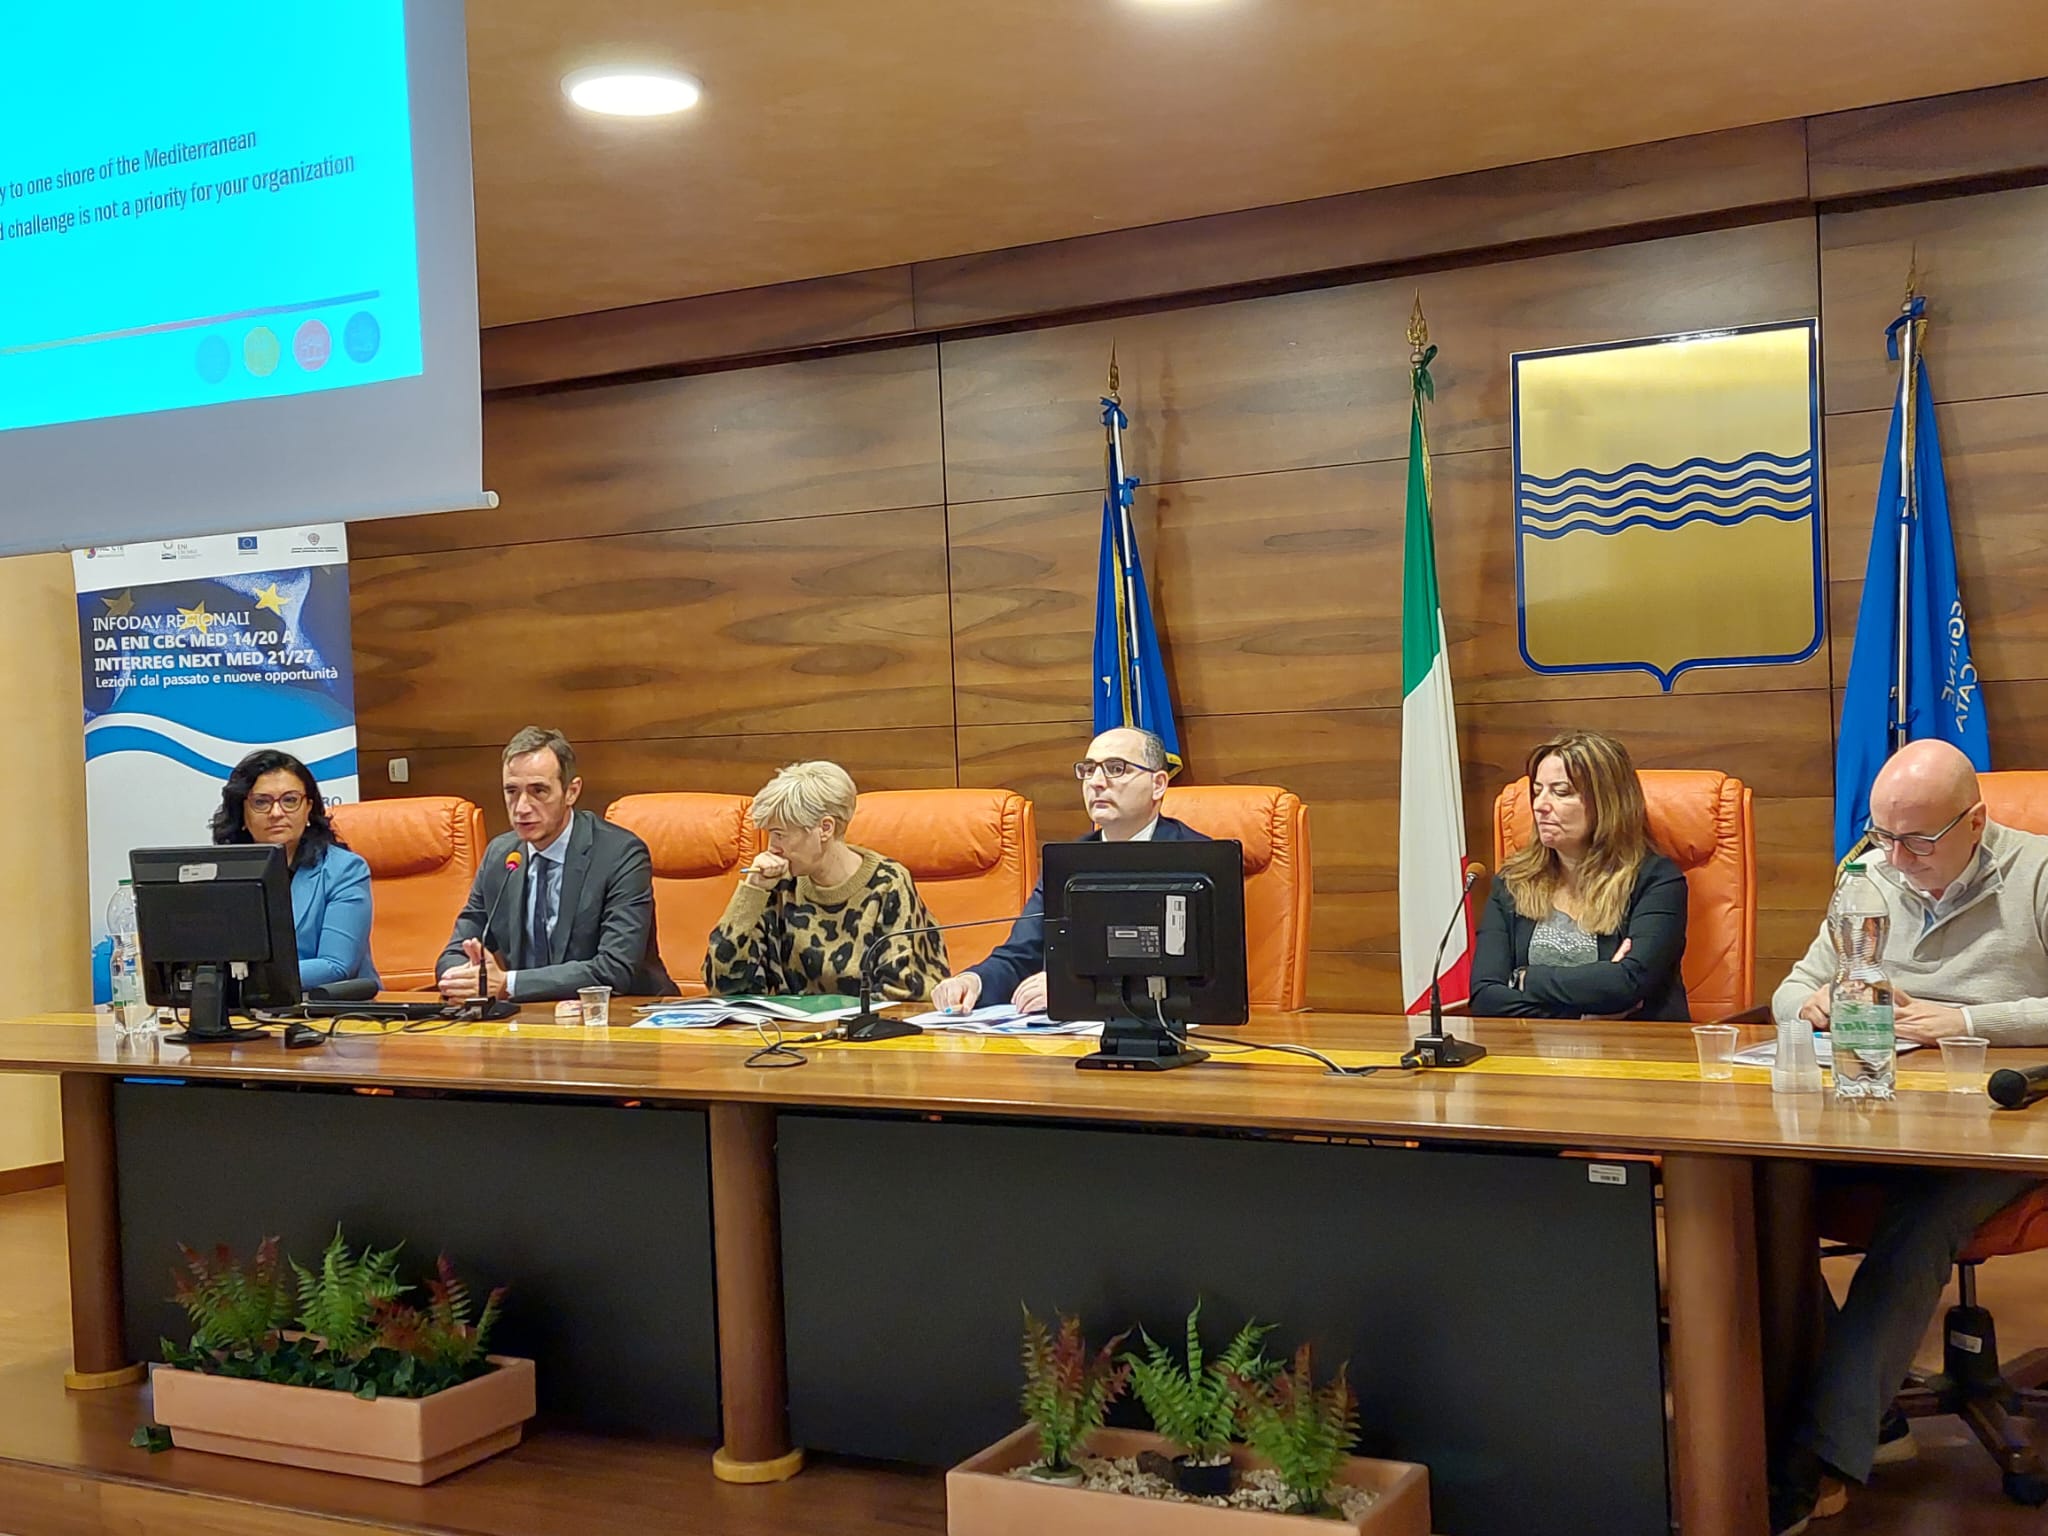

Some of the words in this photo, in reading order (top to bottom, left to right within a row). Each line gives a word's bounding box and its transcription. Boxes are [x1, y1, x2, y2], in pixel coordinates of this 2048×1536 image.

[10, 181, 23, 199] to
[28, 177, 52, 195] one
[56, 168, 95, 189] shore
[100, 158, 113, 180] of
[117, 155, 140, 176] the
[144, 131, 257, 170] Mediterranean
[8, 212, 75, 239] challenge
[79, 205, 91, 225] is
[95, 200, 119, 222] not
[122, 201, 131, 216] a
[135, 187, 187, 219] priority
[191, 182, 212, 203] for
[215, 176, 249, 204] your
[252, 155, 355, 192] organization
[93, 614, 162, 631] INFODAY
[167, 611, 250, 628] REGIONALI
[94, 637, 118, 651] DA
[121, 636, 150, 650] ENI
[153, 634, 186, 649] CBC
[190, 633, 228, 647] MED
[233, 630, 278, 646] 14/20
[282, 630, 294, 644] A
[94, 655, 175, 671] INTERREG
[179, 653, 222, 668] NEXT
[226, 651, 264, 666] MED
[267, 649, 314, 666] 21/27
[96, 674, 137, 688] Lezioni
[140, 674, 159, 686] dal
[163, 674, 210, 688] passato
[213, 675, 221, 684] e
[224, 672, 262, 684] nuove
[264, 666, 338, 684] opportunità
